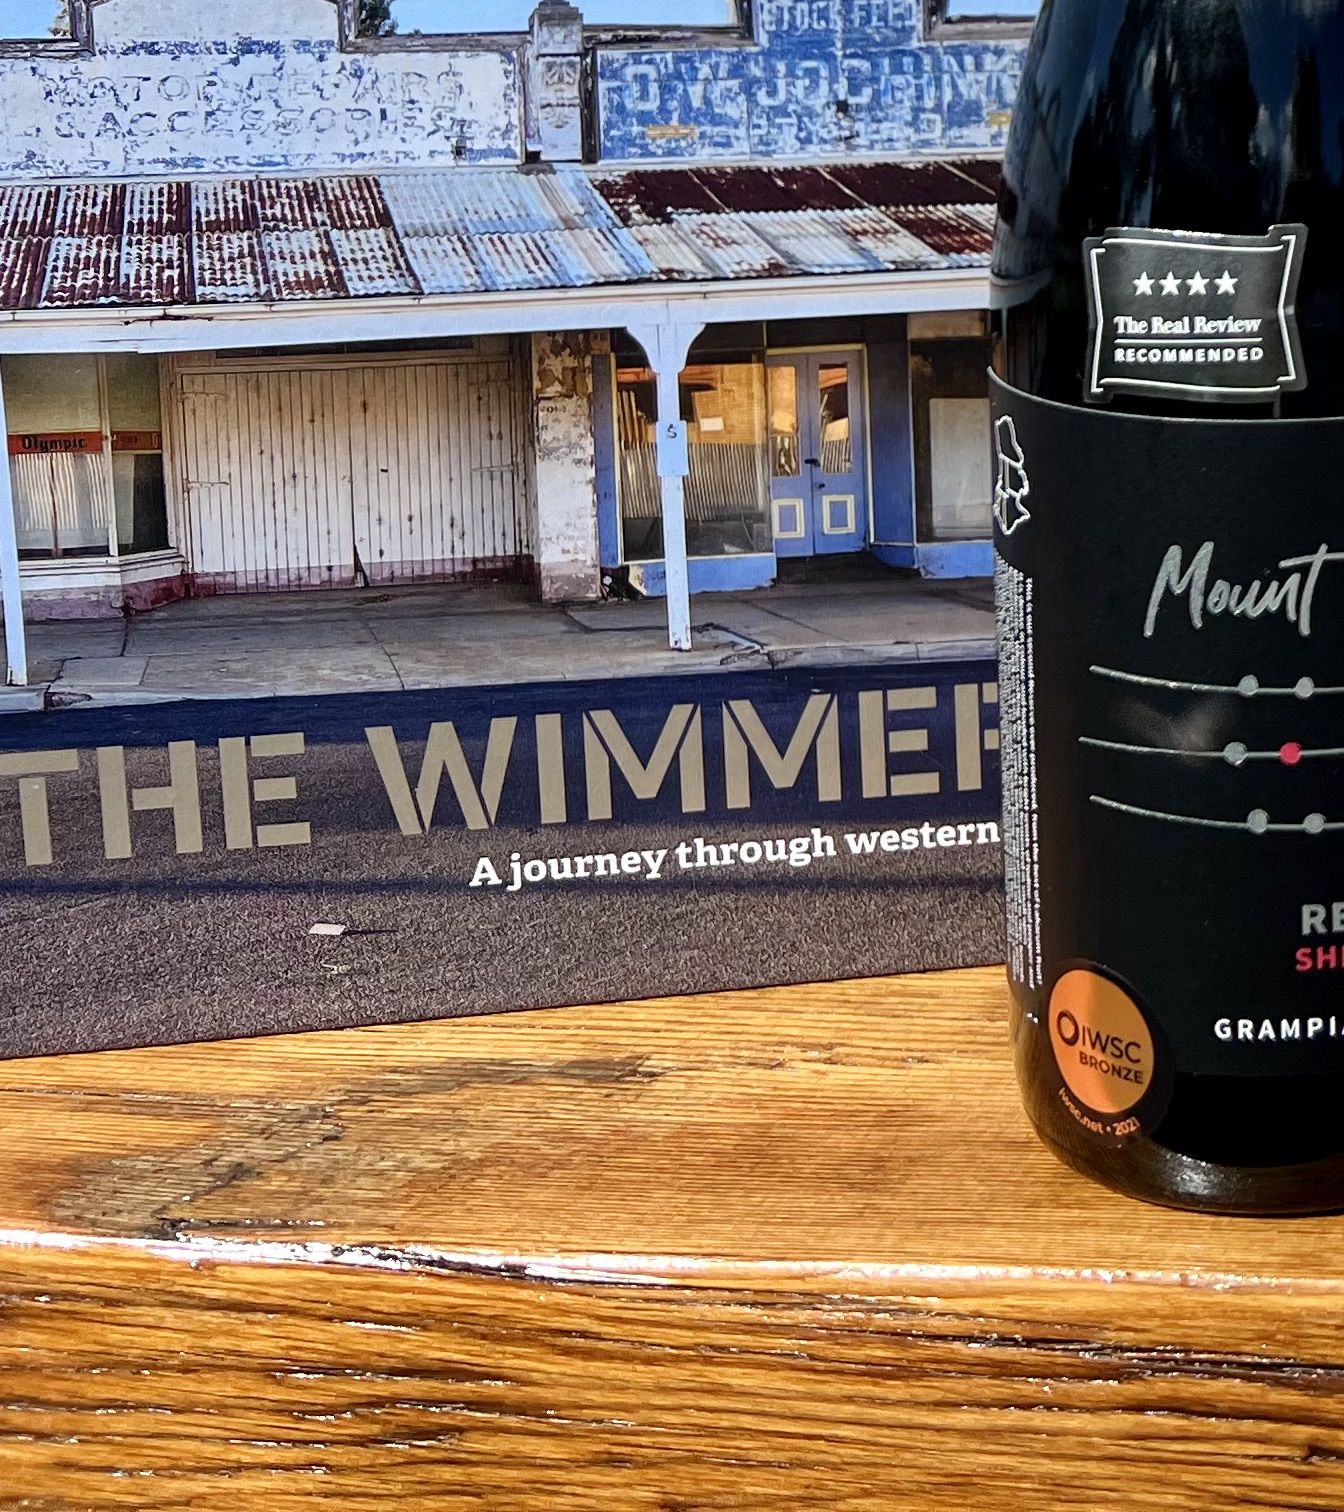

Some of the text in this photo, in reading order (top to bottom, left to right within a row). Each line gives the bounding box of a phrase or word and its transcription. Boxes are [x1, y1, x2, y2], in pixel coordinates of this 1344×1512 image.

[1113, 316, 1262, 334] The Real Review
[1113, 347, 1264, 363] RECOMMENDED
[21, 435, 87, 452] Olympic
[0, 731, 311, 866] THE
[469, 819, 1000, 891] A journey through western
[1079, 1050, 1144, 1085] BRONZE
